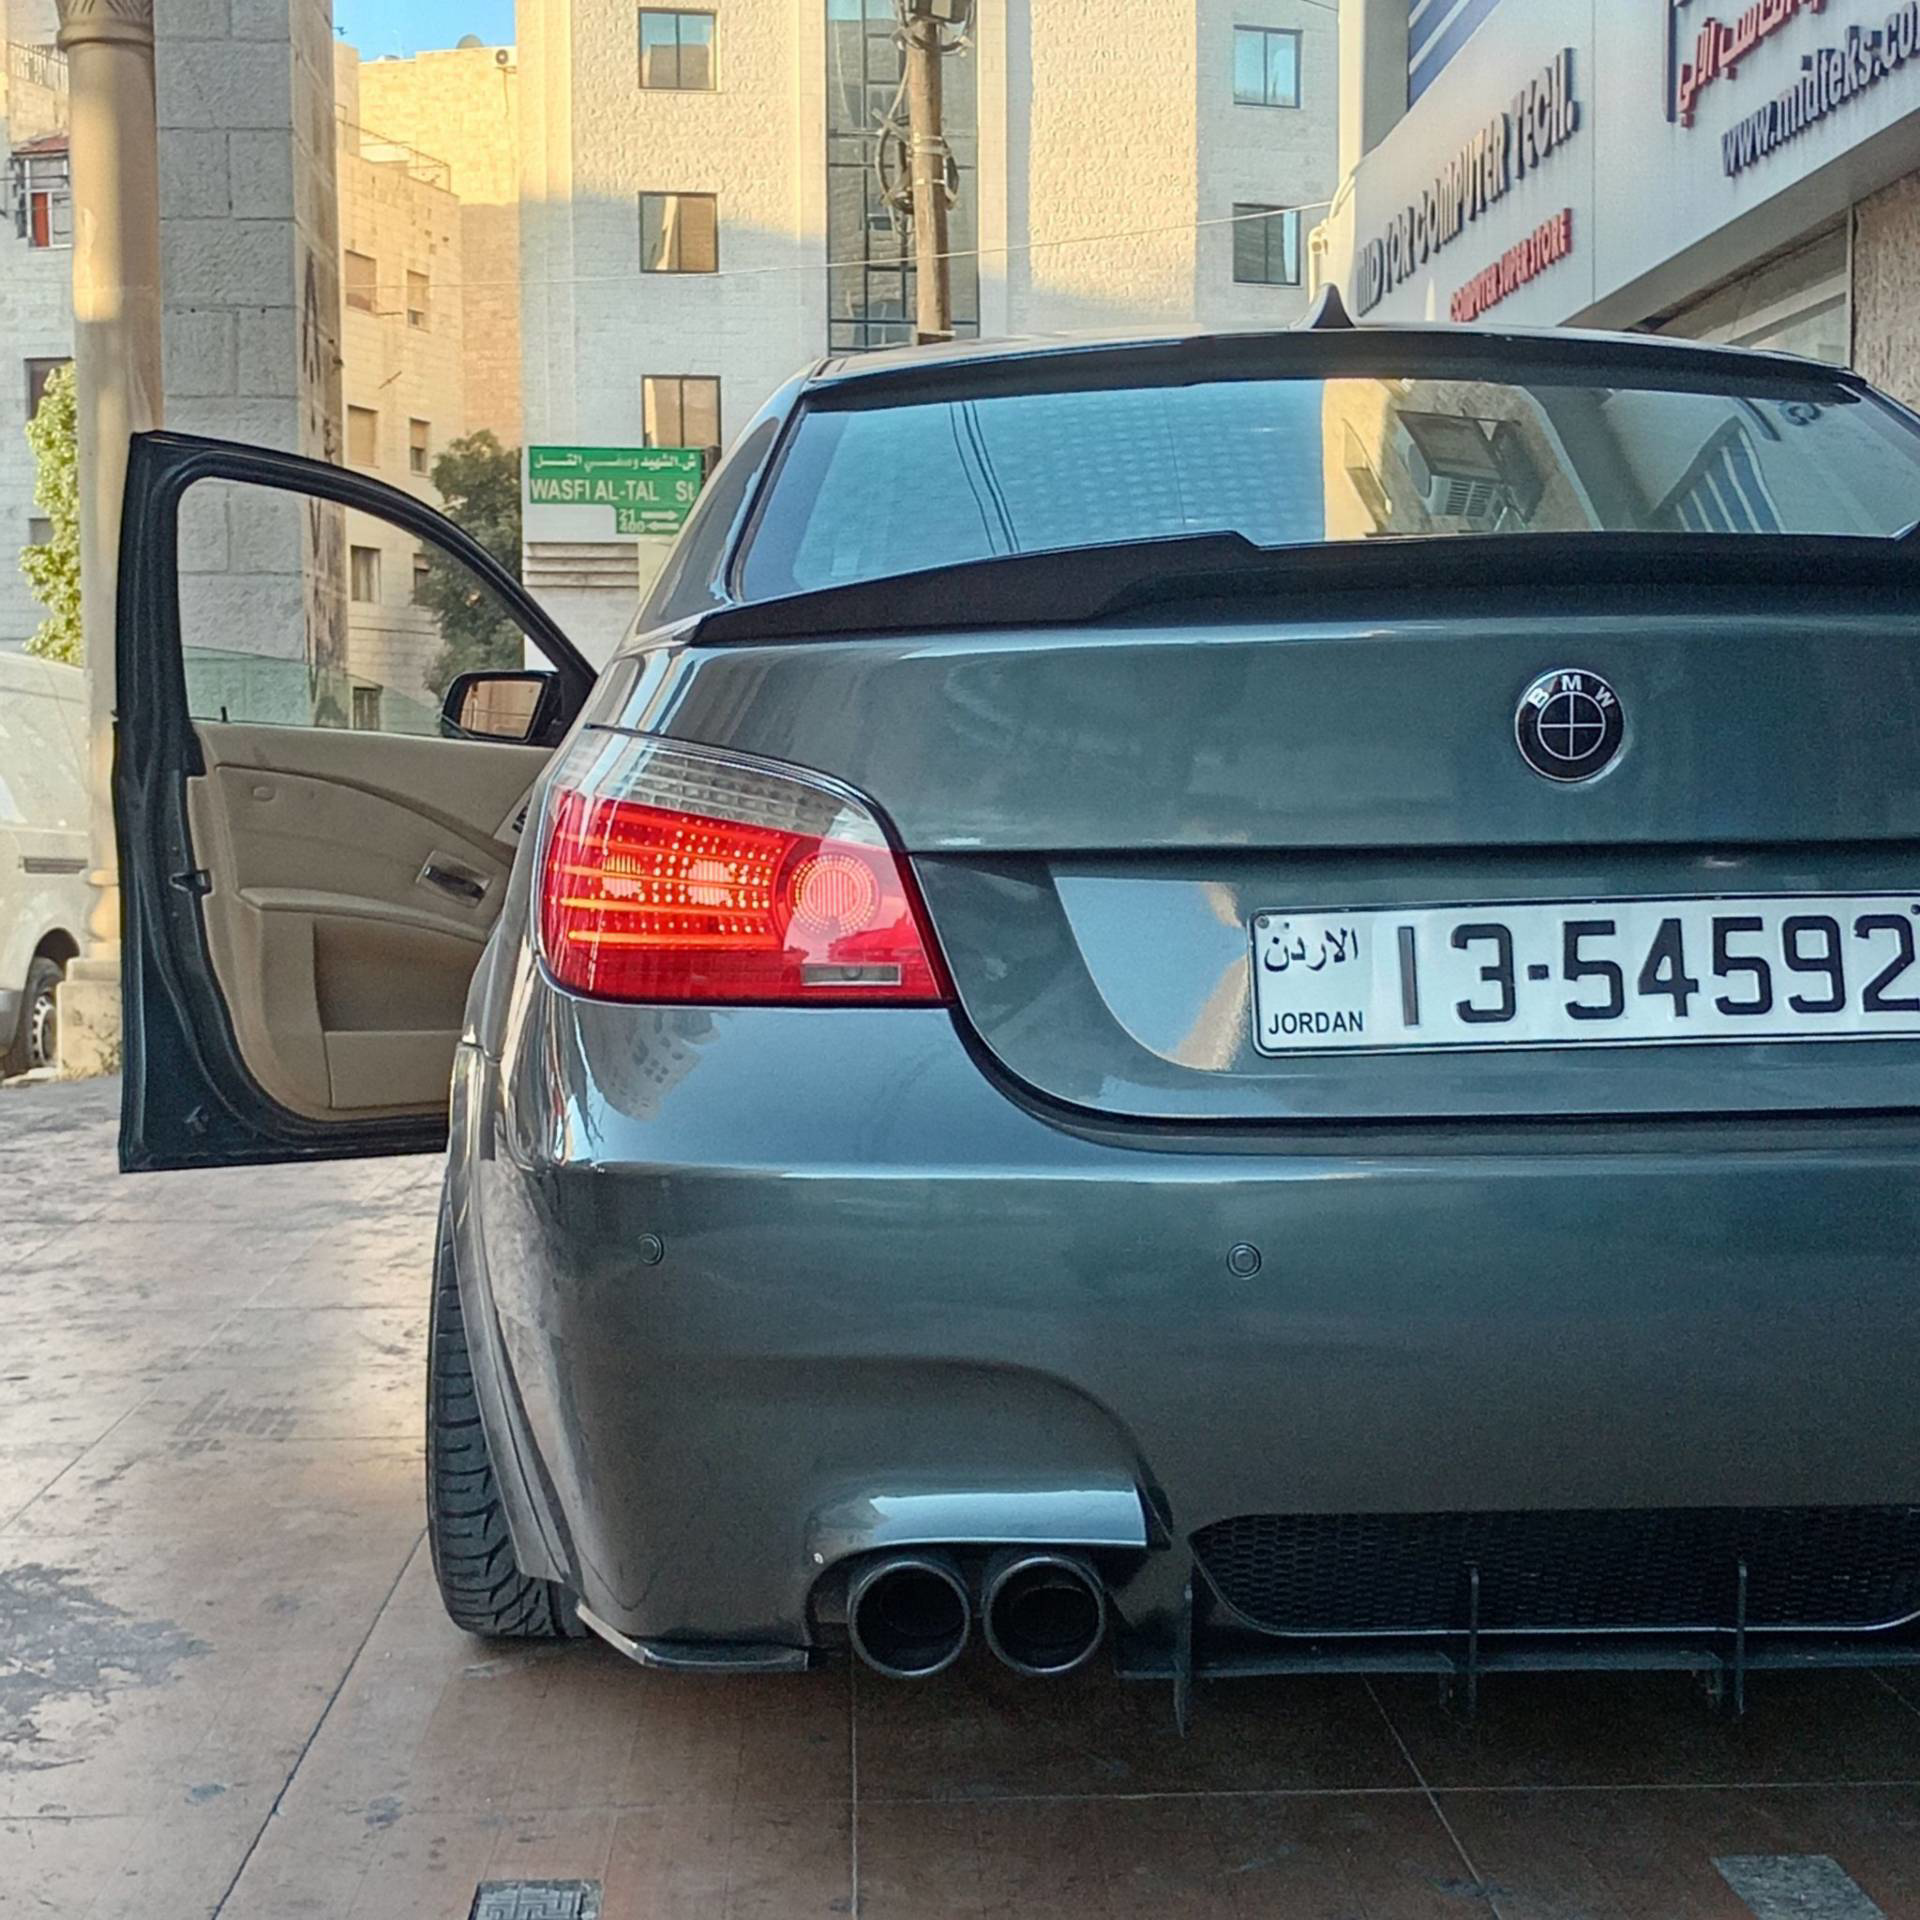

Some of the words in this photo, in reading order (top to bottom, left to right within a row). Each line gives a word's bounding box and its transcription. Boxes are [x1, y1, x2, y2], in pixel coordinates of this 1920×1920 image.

[1722, 0, 1920, 176] www.midteks.co
[1417, 112, 1511, 264] COMPUTER
[530, 478, 591, 500] WASFI
[594, 479, 660, 502] AL-TAL
[1527, 674, 1616, 709] BMW
[1268, 1010, 1364, 1035] JORDAN
